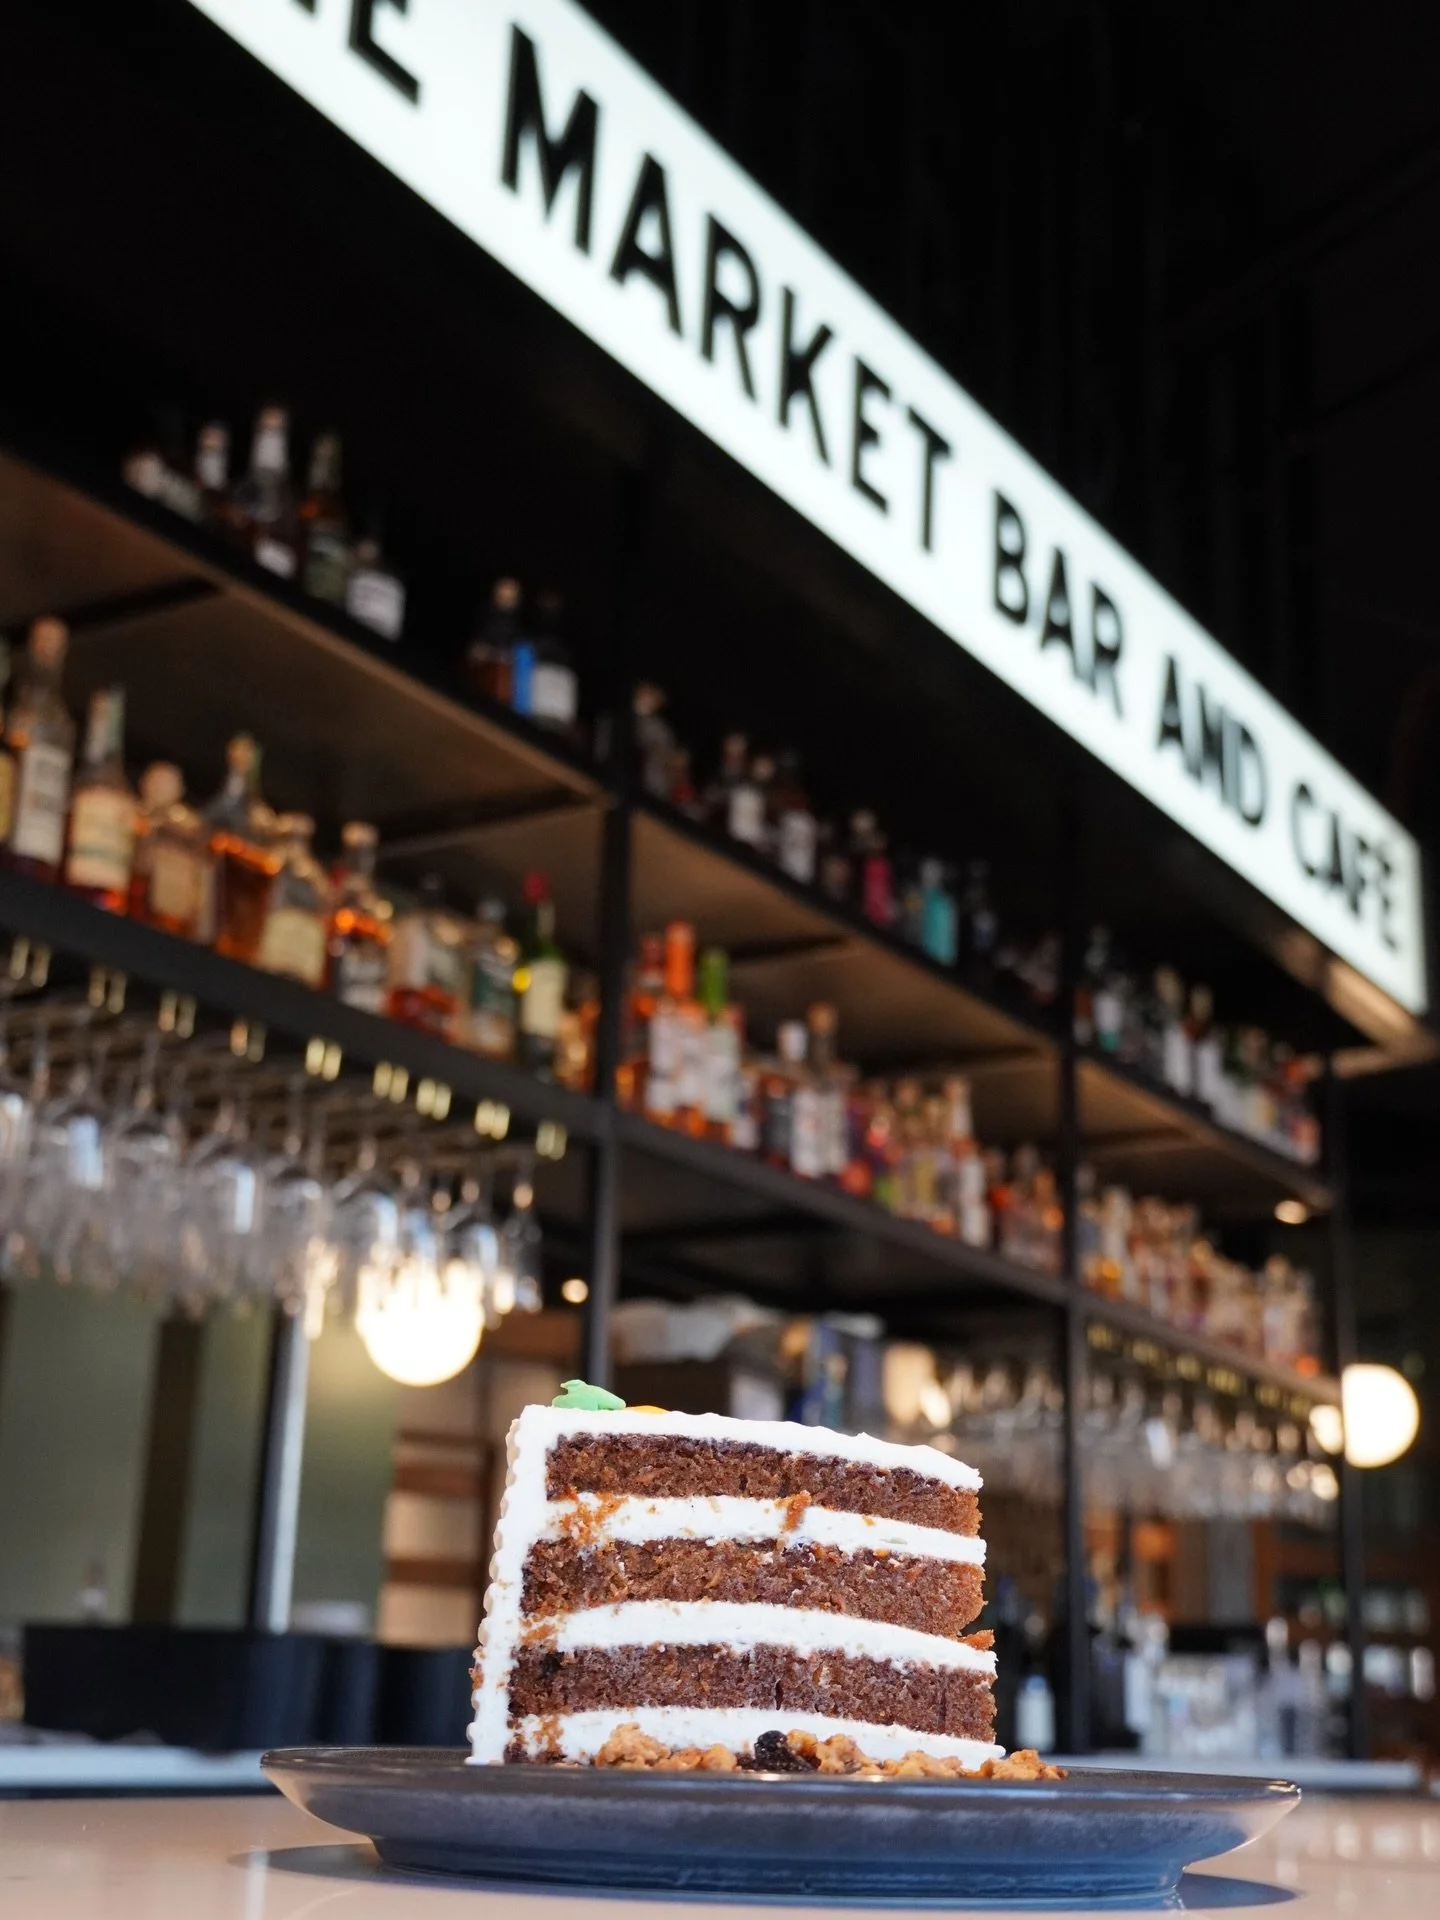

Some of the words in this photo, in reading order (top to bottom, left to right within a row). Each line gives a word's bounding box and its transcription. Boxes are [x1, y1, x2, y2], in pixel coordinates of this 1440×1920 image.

[500, 22, 953, 553] MARKET
[993, 489, 1125, 716] BAR
[1156, 654, 1266, 829] AND
